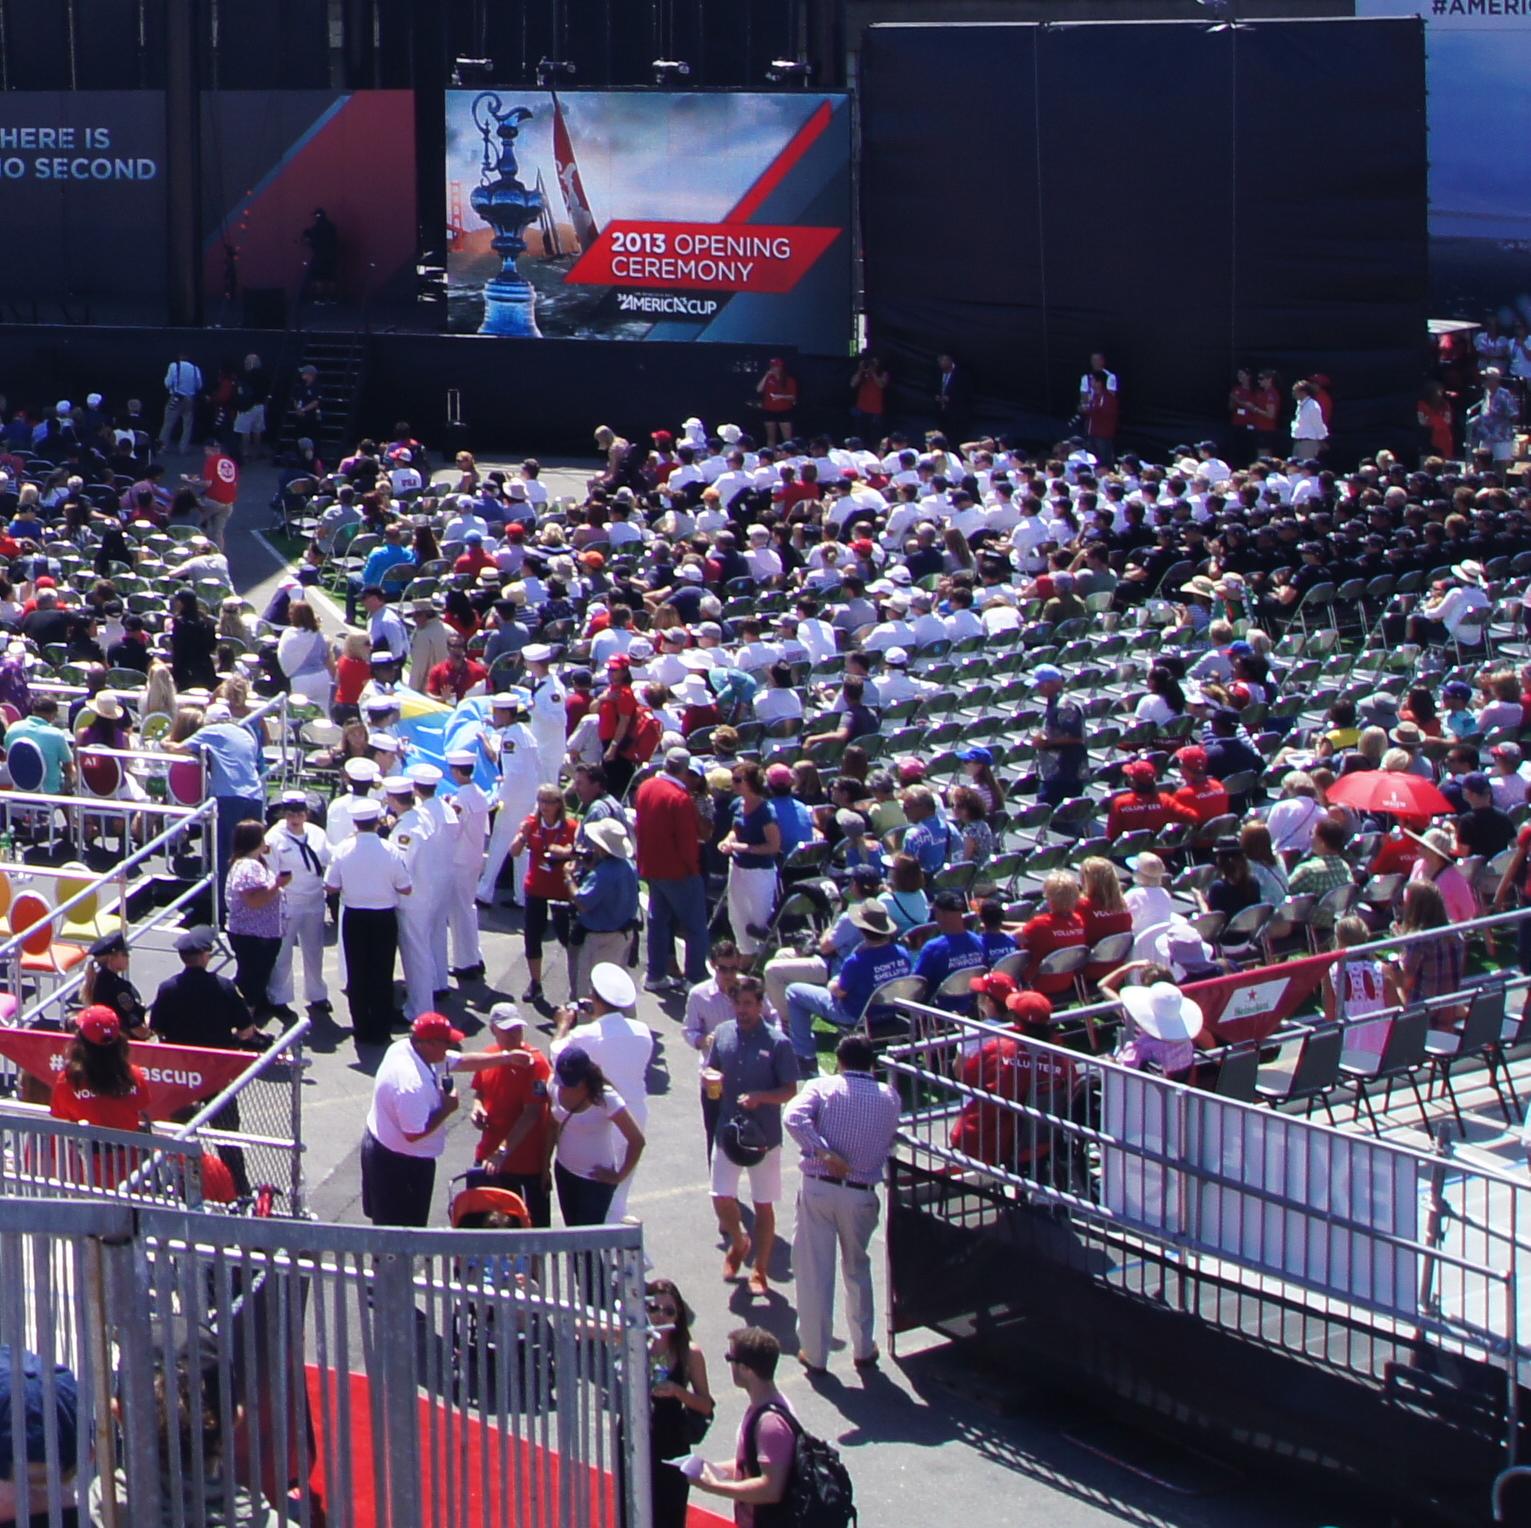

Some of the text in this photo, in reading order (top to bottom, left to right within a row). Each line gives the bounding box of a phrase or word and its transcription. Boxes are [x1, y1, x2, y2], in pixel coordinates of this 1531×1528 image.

[85, 127, 110, 149] IS
[35, 157, 156, 180] SECOND
[611, 231, 791, 259] 2013 OPENING
[611, 256, 753, 282] CEREMONY
[687, 300, 717, 314] CUP
